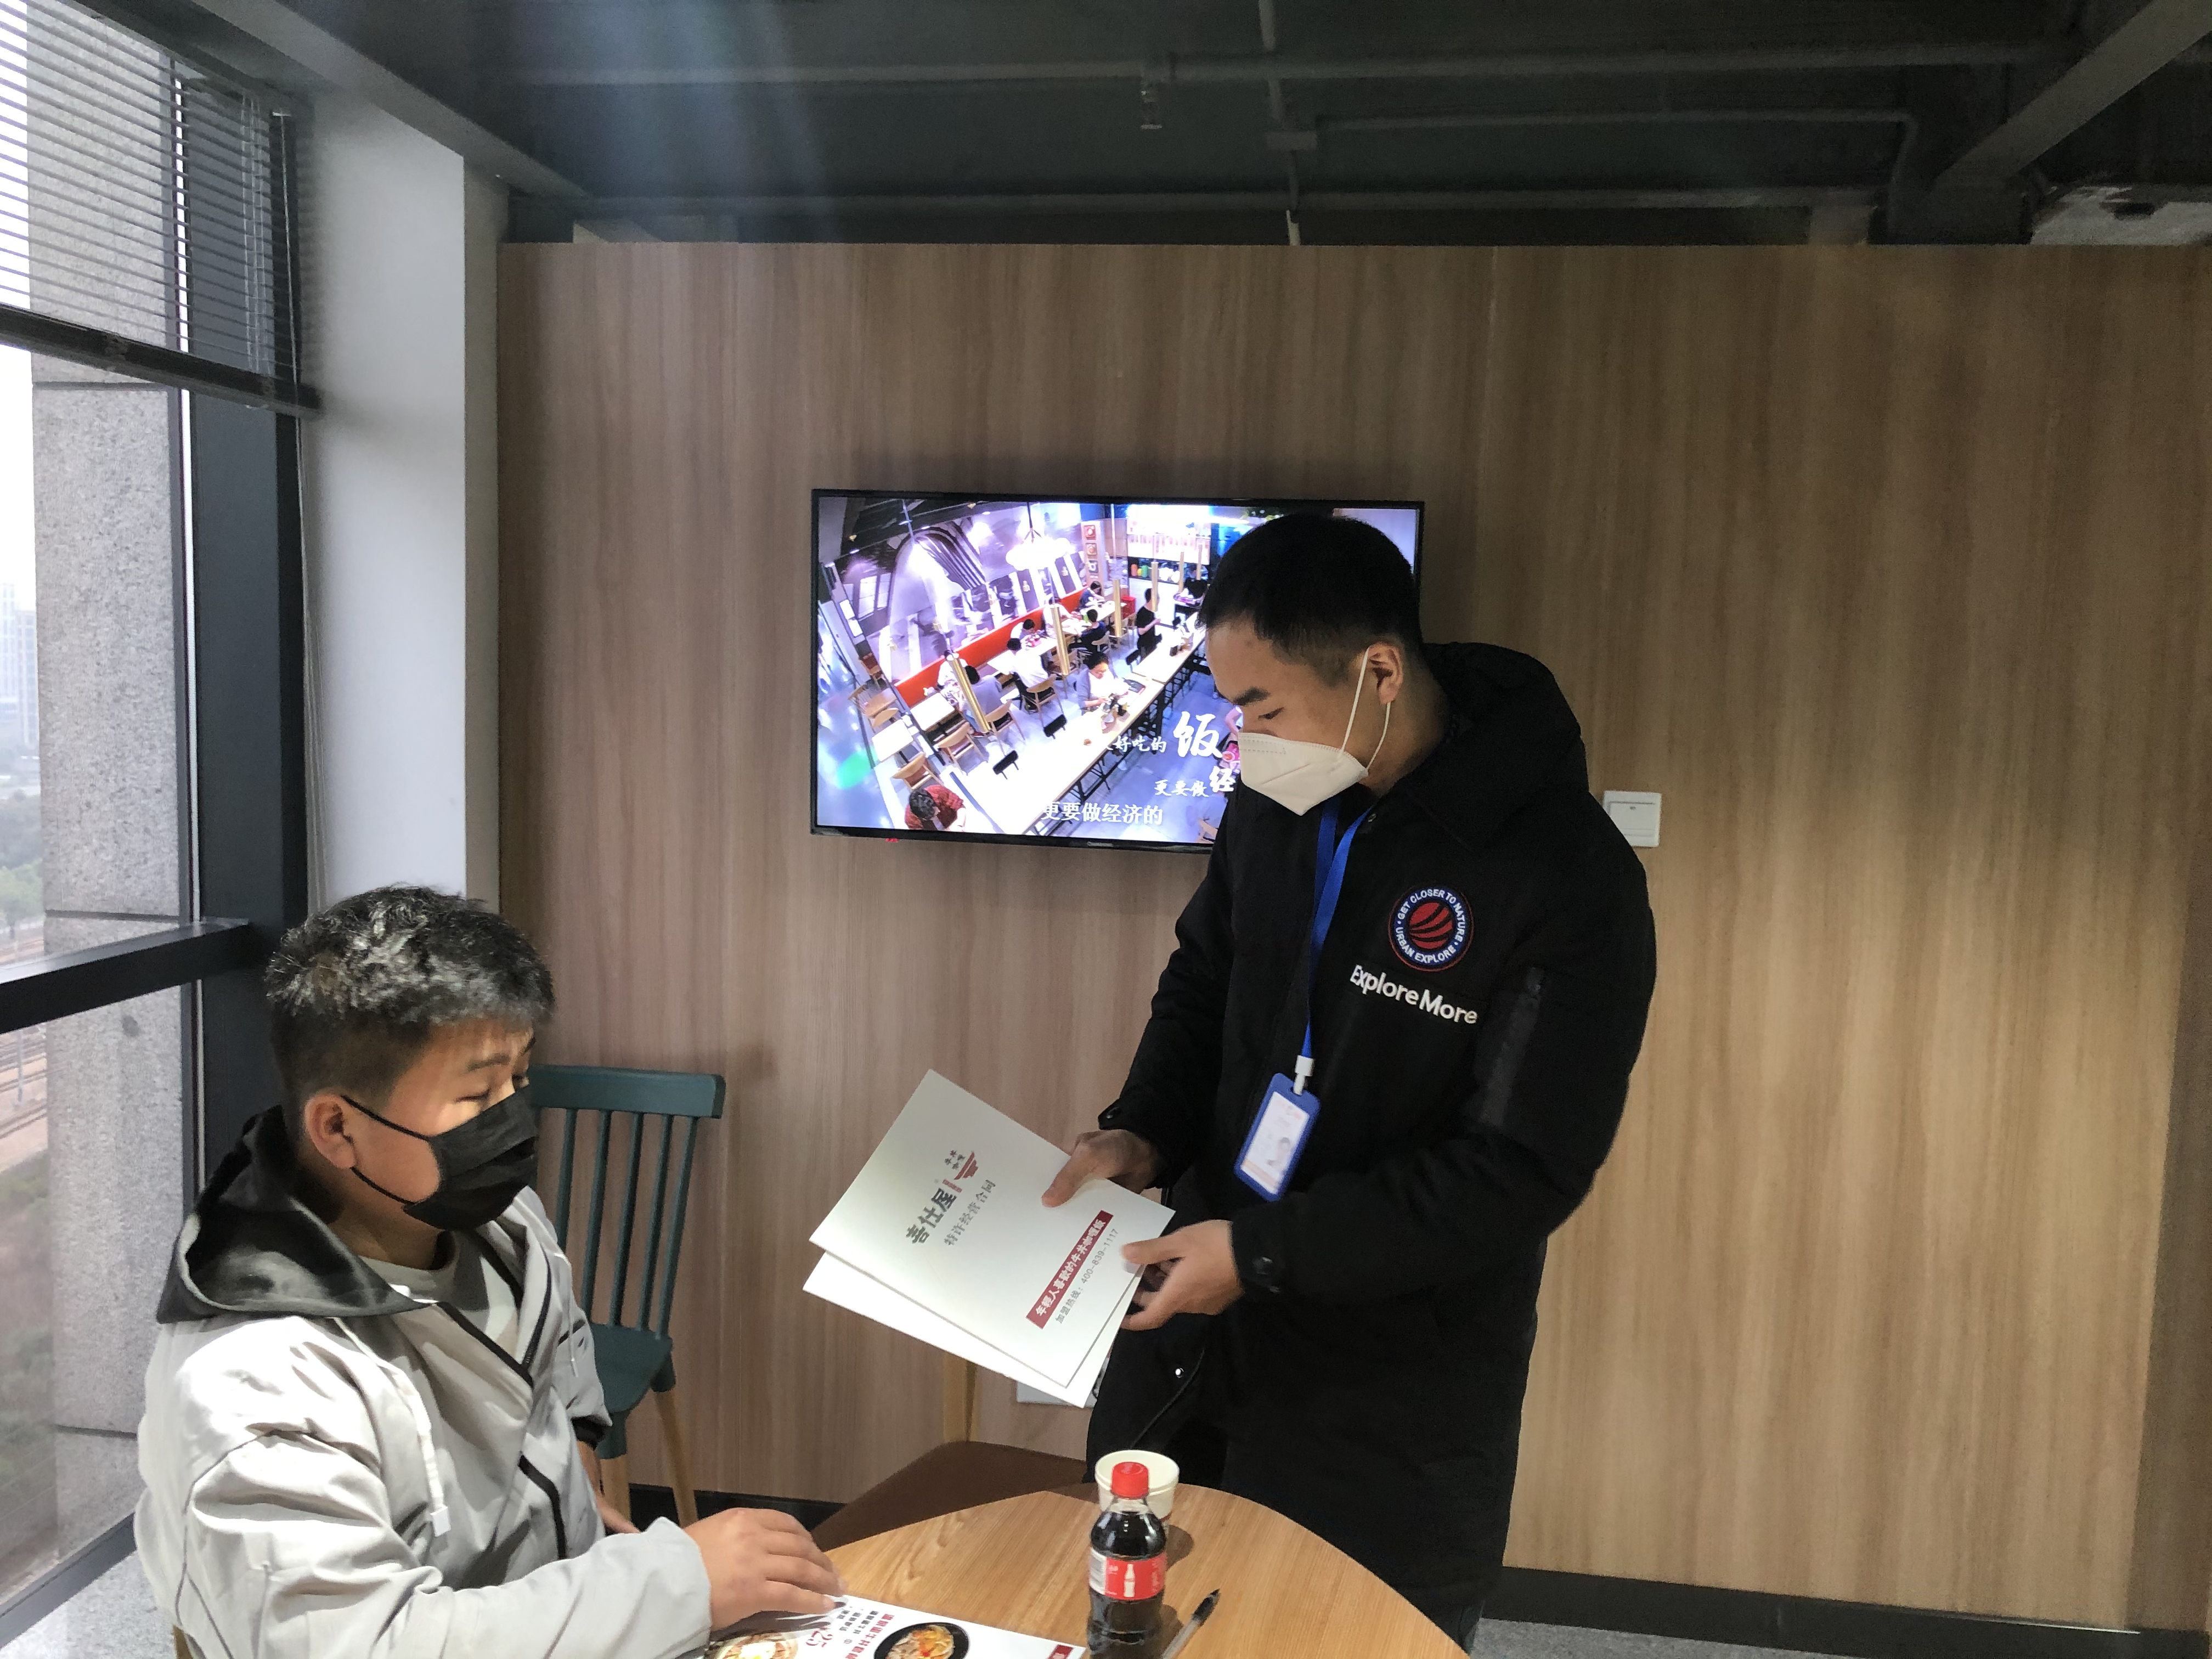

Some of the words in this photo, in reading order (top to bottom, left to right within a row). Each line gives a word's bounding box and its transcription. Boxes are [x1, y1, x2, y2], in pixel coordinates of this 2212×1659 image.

[1041, 802, 1163, 825] 更要做经济的
[1397, 901, 1410, 919] GET
[1410, 889, 1445, 903] CLOSER
[1446, 892, 1456, 904] TO
[1453, 902, 1465, 943] NATURE
[1396, 927, 1415, 957] URBAN
[1414, 945, 1456, 963] EXPLORE
